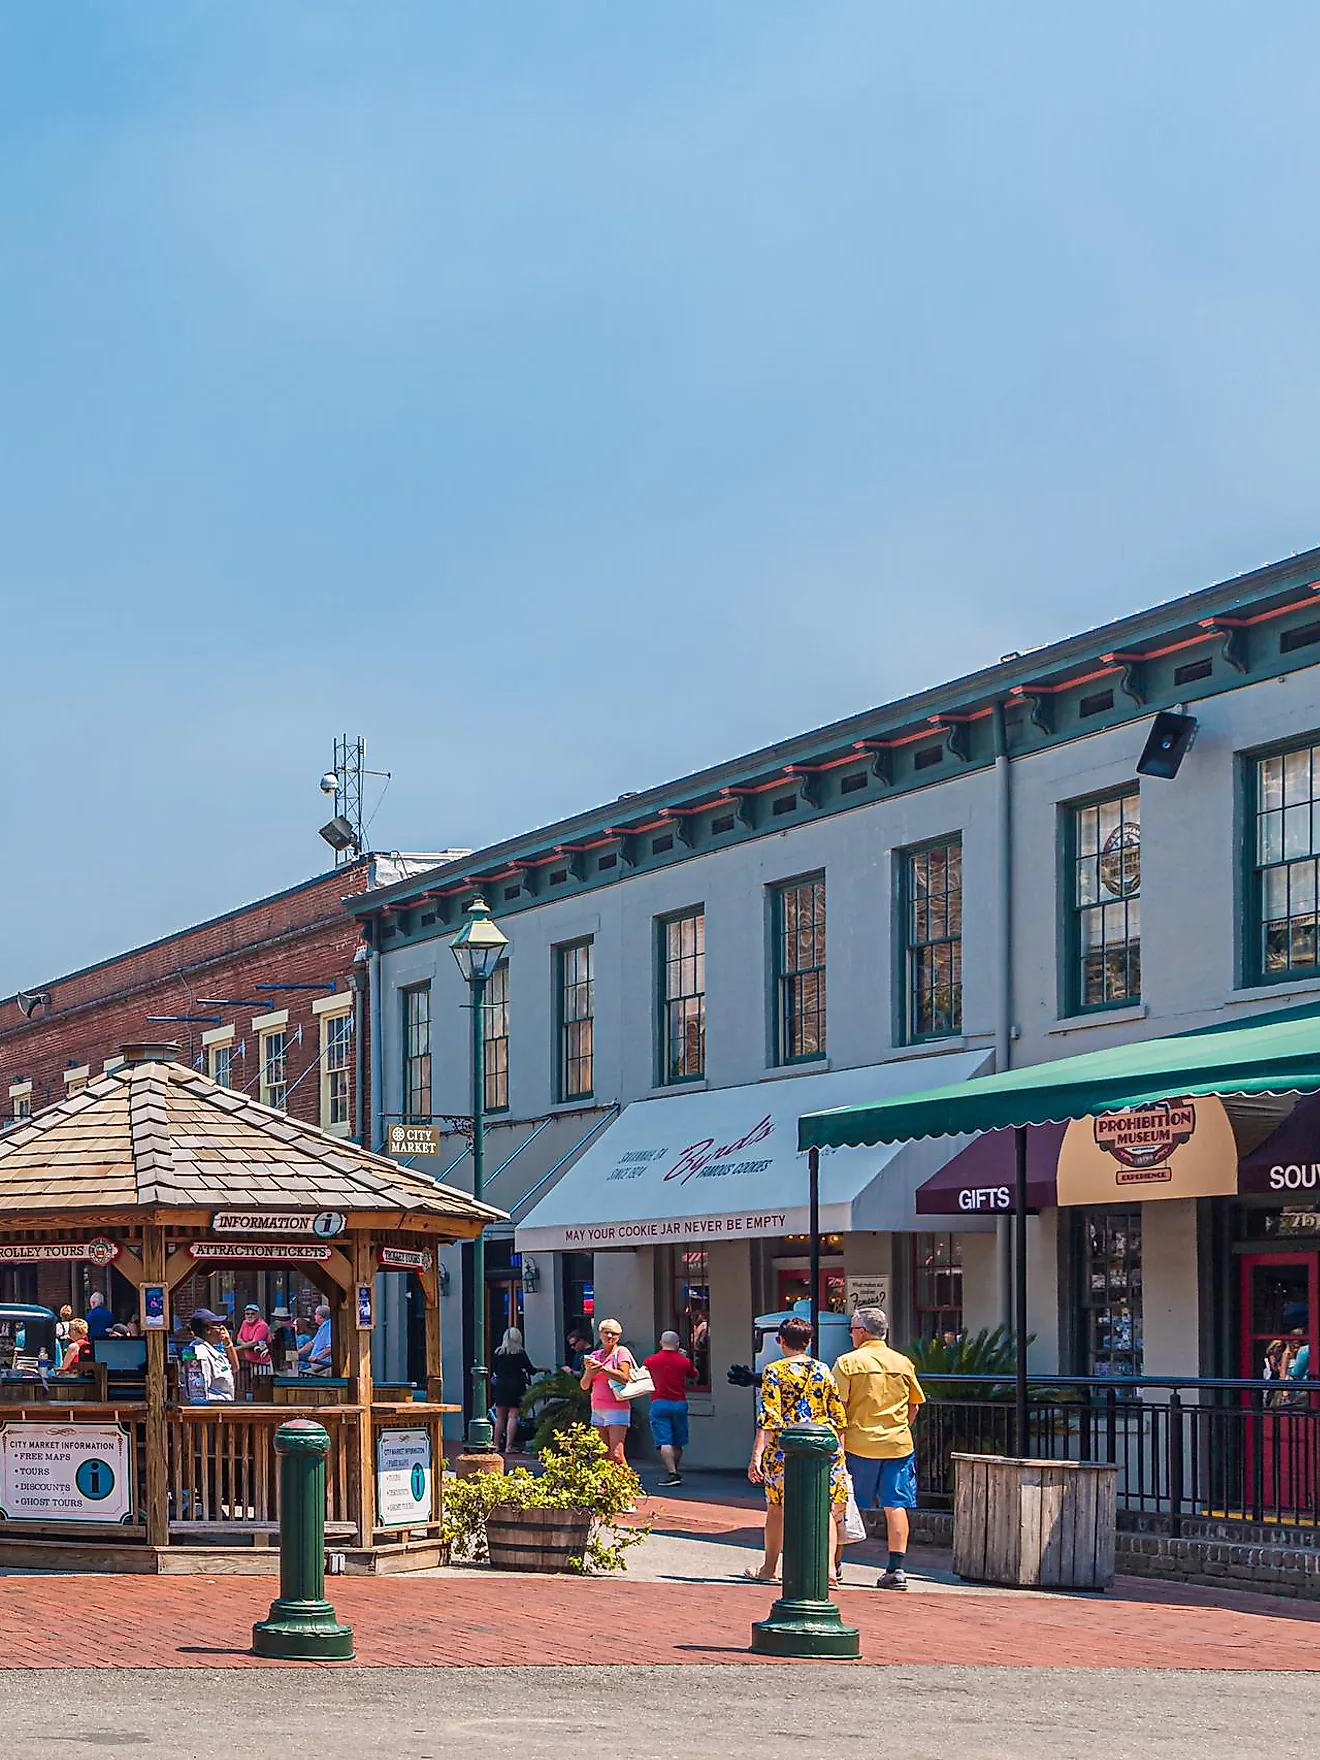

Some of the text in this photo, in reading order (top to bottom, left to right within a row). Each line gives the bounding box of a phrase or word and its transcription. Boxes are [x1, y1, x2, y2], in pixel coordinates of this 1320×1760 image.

[1098, 1111, 1191, 1133] PROHIBITION
[406, 1130, 432, 1141] CITY
[1117, 1130, 1170, 1145] MUSEUM
[391, 1141, 436, 1153] MARKET
[696, 1160, 773, 1179] FAMOUS COOKIES
[1121, 1172, 1166, 1181] EXPERIENCE
[958, 1187, 1010, 1209] GIFTS
[219, 1216, 310, 1229] INFORMATION
[565, 1215, 786, 1241] MAY YOUR COOKIE JAR NEVER BE EMPTY
[43, 1246, 84, 1257] TOURS
[196, 1245, 327, 1258] ATTRACTION TICKETS
[29, 1441, 59, 1449] MARKET
[61, 1442, 114, 1450] INFORMATION
[19, 1452, 71, 1461] FREE MAPS
[20, 1468, 50, 1476] TOURS
[20, 1483, 71, 1491] DISCOUNTS
[20, 1498, 83, 1508] GHOST TOURS
